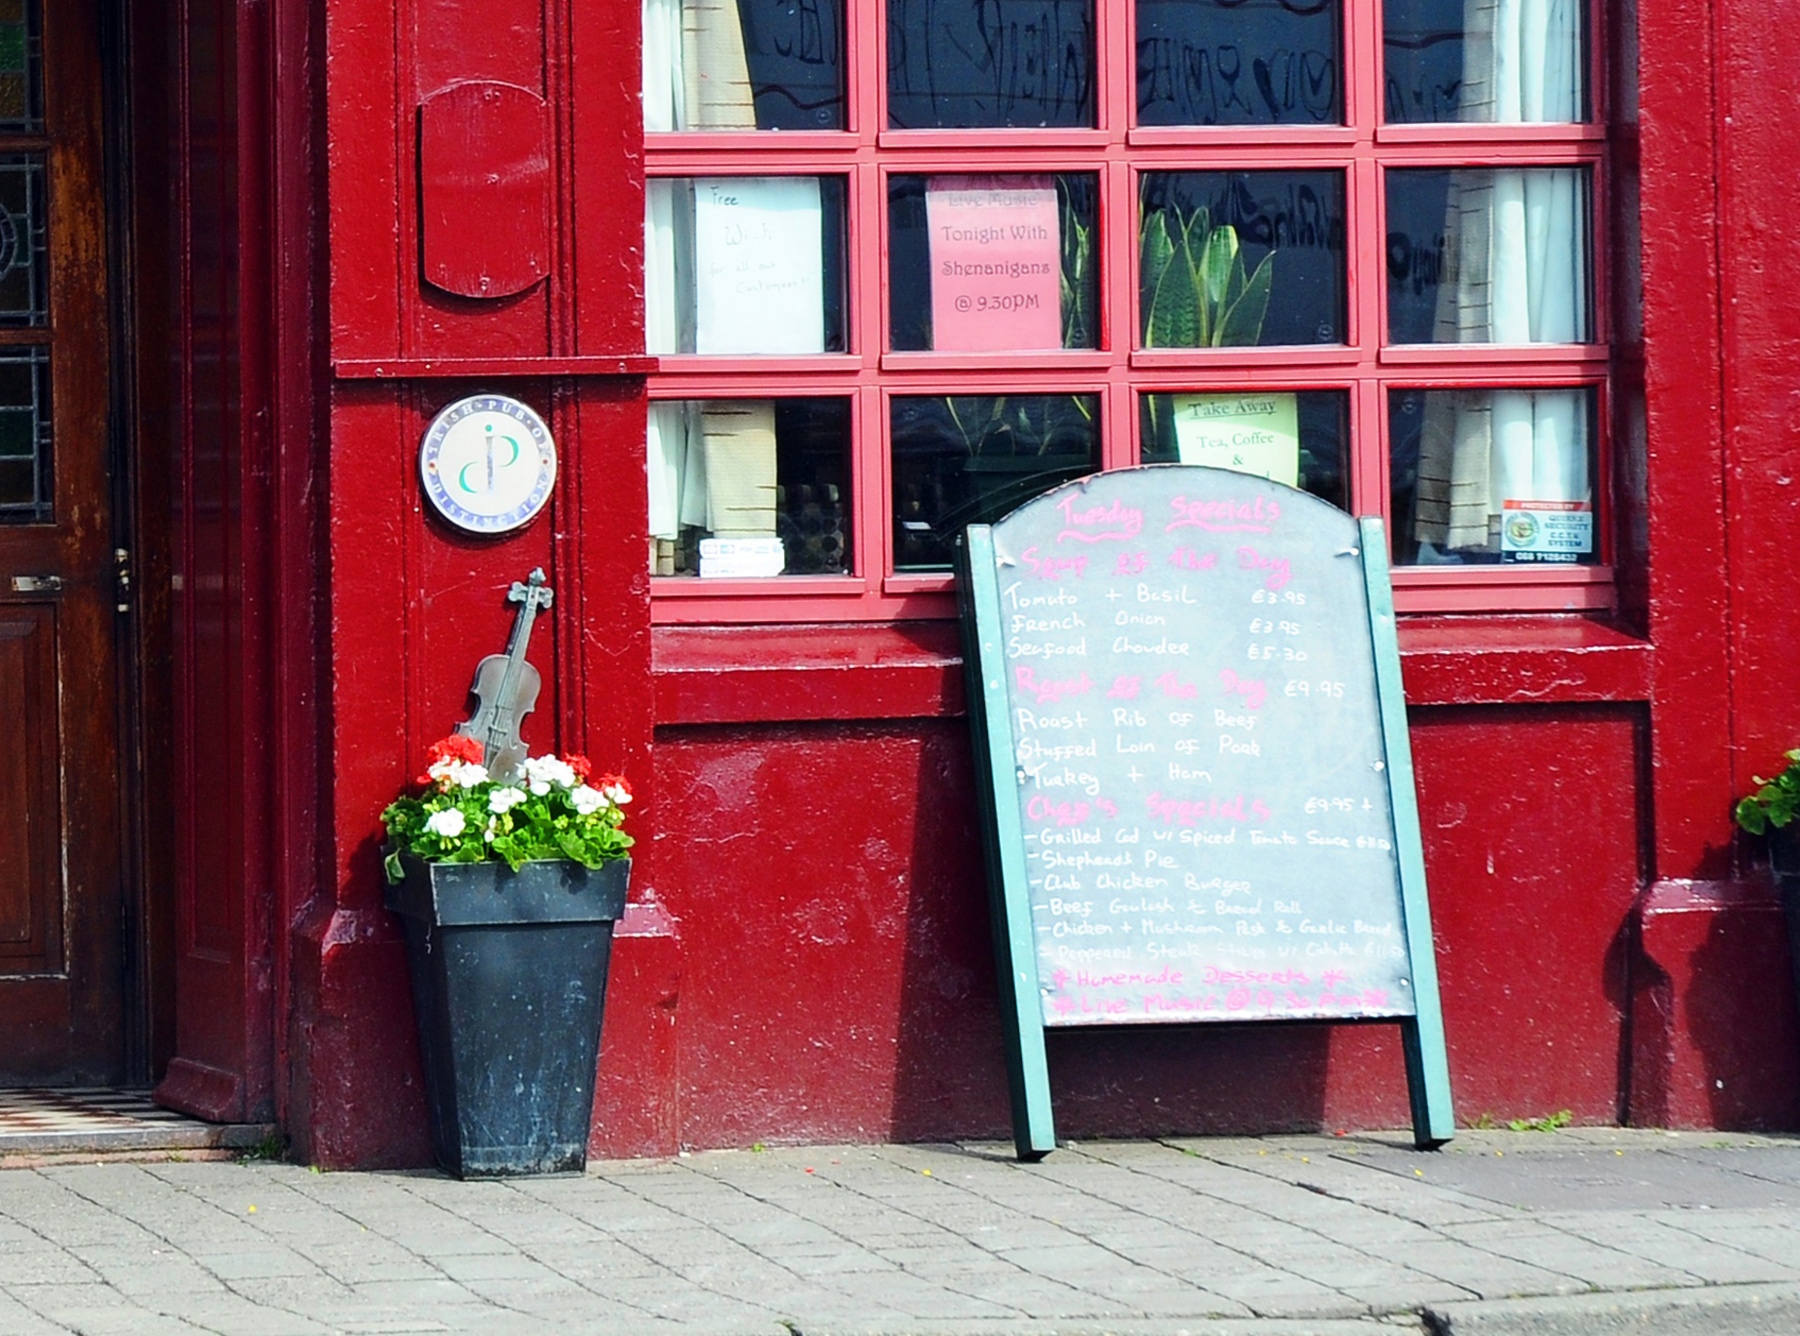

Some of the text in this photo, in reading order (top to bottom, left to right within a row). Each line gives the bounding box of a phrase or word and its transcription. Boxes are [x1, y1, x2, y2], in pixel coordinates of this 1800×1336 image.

[948, 193, 1039, 207] Live Music
[941, 225, 1047, 244] Tonight With
[941, 261, 1050, 279] Shenanigans
[954, 295, 972, 312] @
[488, 400, 526, 422] PUB
[1188, 400, 1277, 417] Take Away
[1231, 431, 1275, 446] Coffee
[1231, 453, 1244, 466] &
[1169, 494, 1281, 525] Specials
[1235, 545, 1293, 590] Day
[1003, 581, 1079, 610] Tomato
[1113, 610, 1166, 627] Onion
[1008, 636, 1087, 660] Seafood
[1218, 667, 1269, 710] Day
[1017, 708, 1089, 732] Roast
[1112, 707, 1147, 728] Rib
[1213, 707, 1258, 731] Beef
[1017, 735, 1097, 762] Stuffed
[1115, 735, 1156, 755] Loin
[1029, 763, 1100, 796] Turkey
[1168, 764, 1212, 783] Ham
[1040, 828, 1103, 845] Grilled
[1179, 827, 1236, 847] Spiced
[1144, 848, 1180, 869] Pie
[1096, 871, 1169, 891] Chicken
[1049, 897, 1094, 918] Beef
[1051, 920, 1114, 938] Chicken
[1076, 964, 1312, 988] Homemade Desserts
[1080, 994, 1129, 1015] Live
[1142, 995, 1217, 1014] Music
